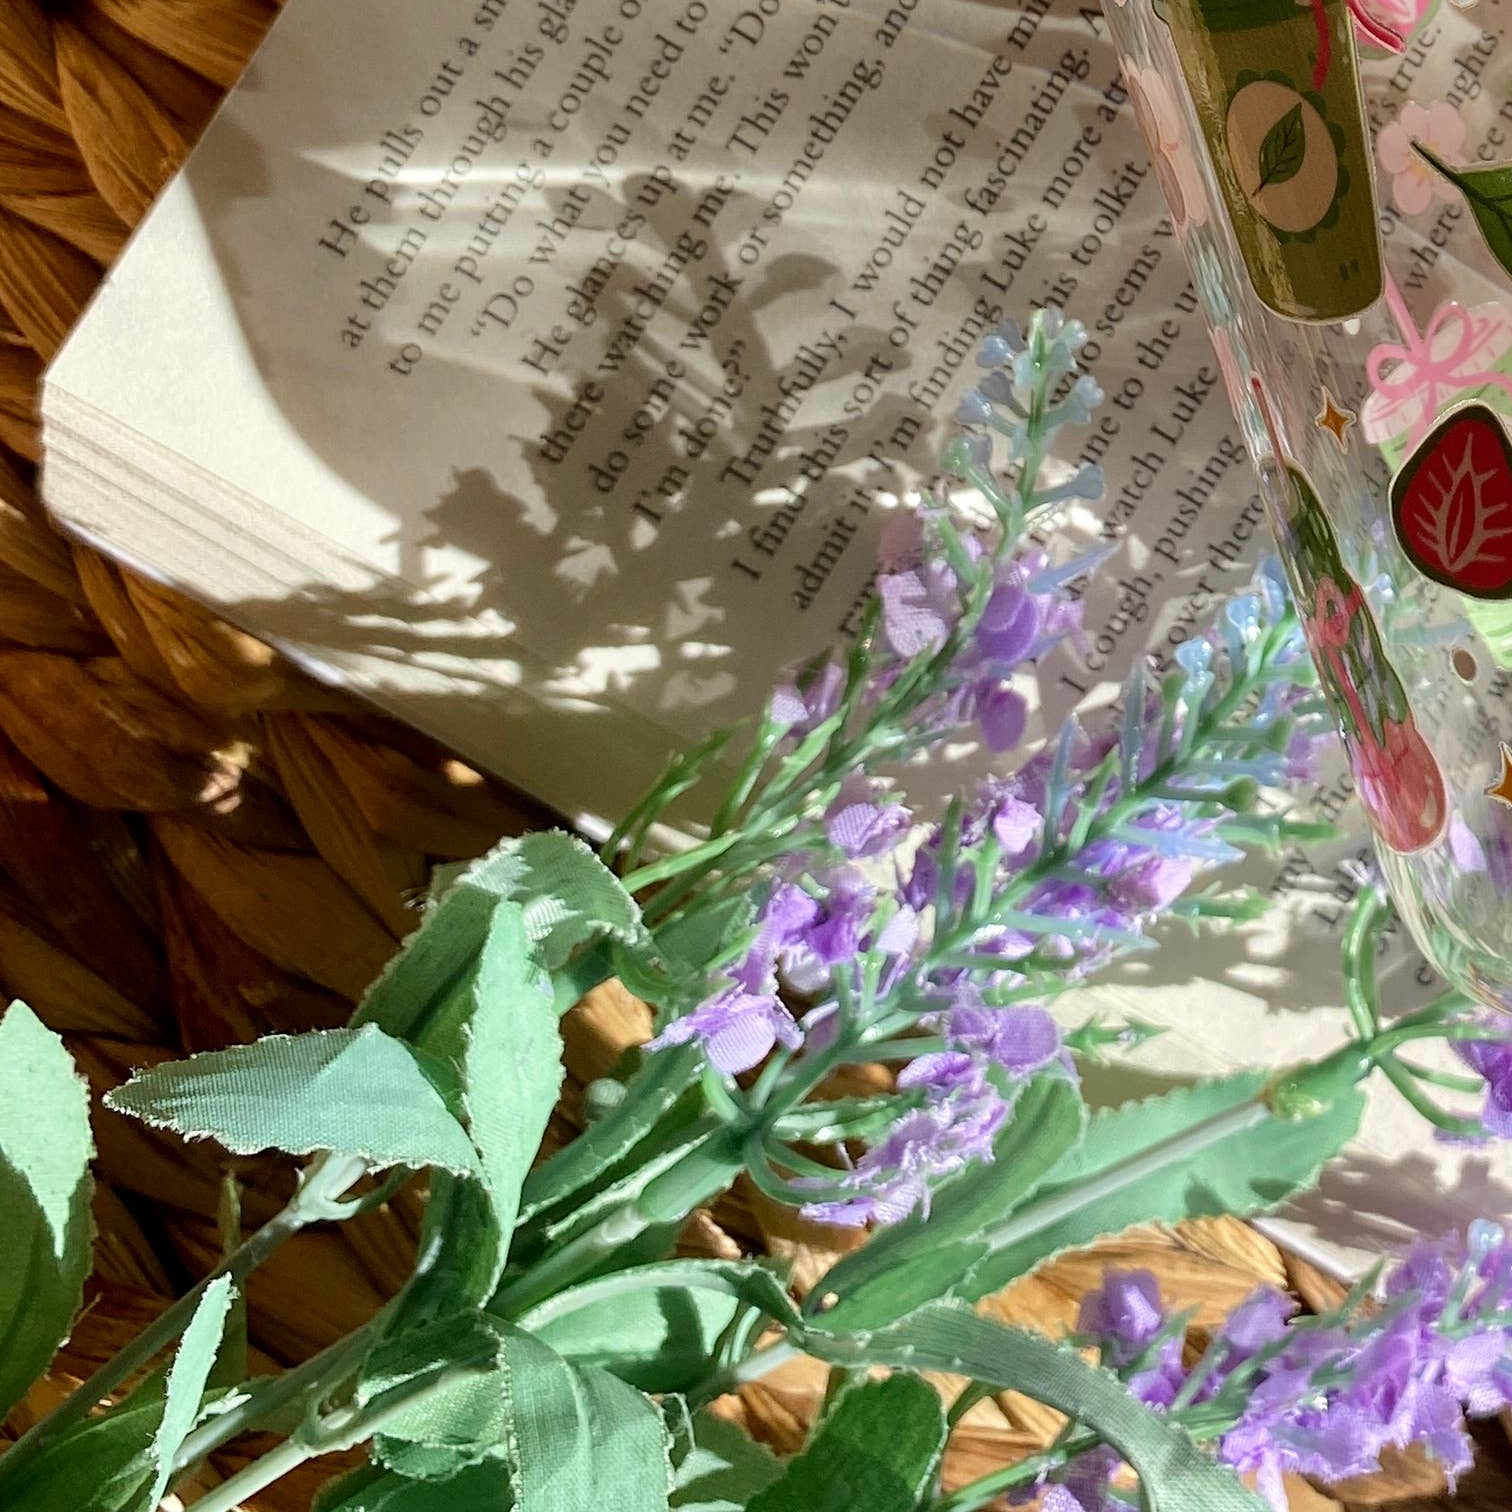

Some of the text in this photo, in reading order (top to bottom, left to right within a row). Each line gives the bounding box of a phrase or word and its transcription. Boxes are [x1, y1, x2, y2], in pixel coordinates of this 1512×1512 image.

[316, 205, 371, 258] He
[363, 127, 423, 205] pulls
[419, 60, 464, 117] out
[458, 36, 481, 56] a
[340, 314, 371, 348] at
[358, 227, 427, 311] them
[414, 95, 512, 222] through
[492, 44, 544, 90] his
[388, 343, 422, 376] to
[416, 282, 461, 336] me
[452, 161, 543, 284] putting
[532, 137, 554, 157] a
[547, 25, 623, 133] couple
[1069, 161, 1152, 266] toolkit.
[730, 559, 761, 580] I
[797, 427, 848, 483] this
[842, 353, 893, 414] sort
[887, 299, 919, 347] of
[908, 219, 983, 306] thing
[962, 48, 1090, 217] fascinating.
[791, 518, 857, 610] admit
[907, 294, 1003, 410] finding
[978, 213, 1048, 294] Luke
[1040, 125, 1102, 210] more
